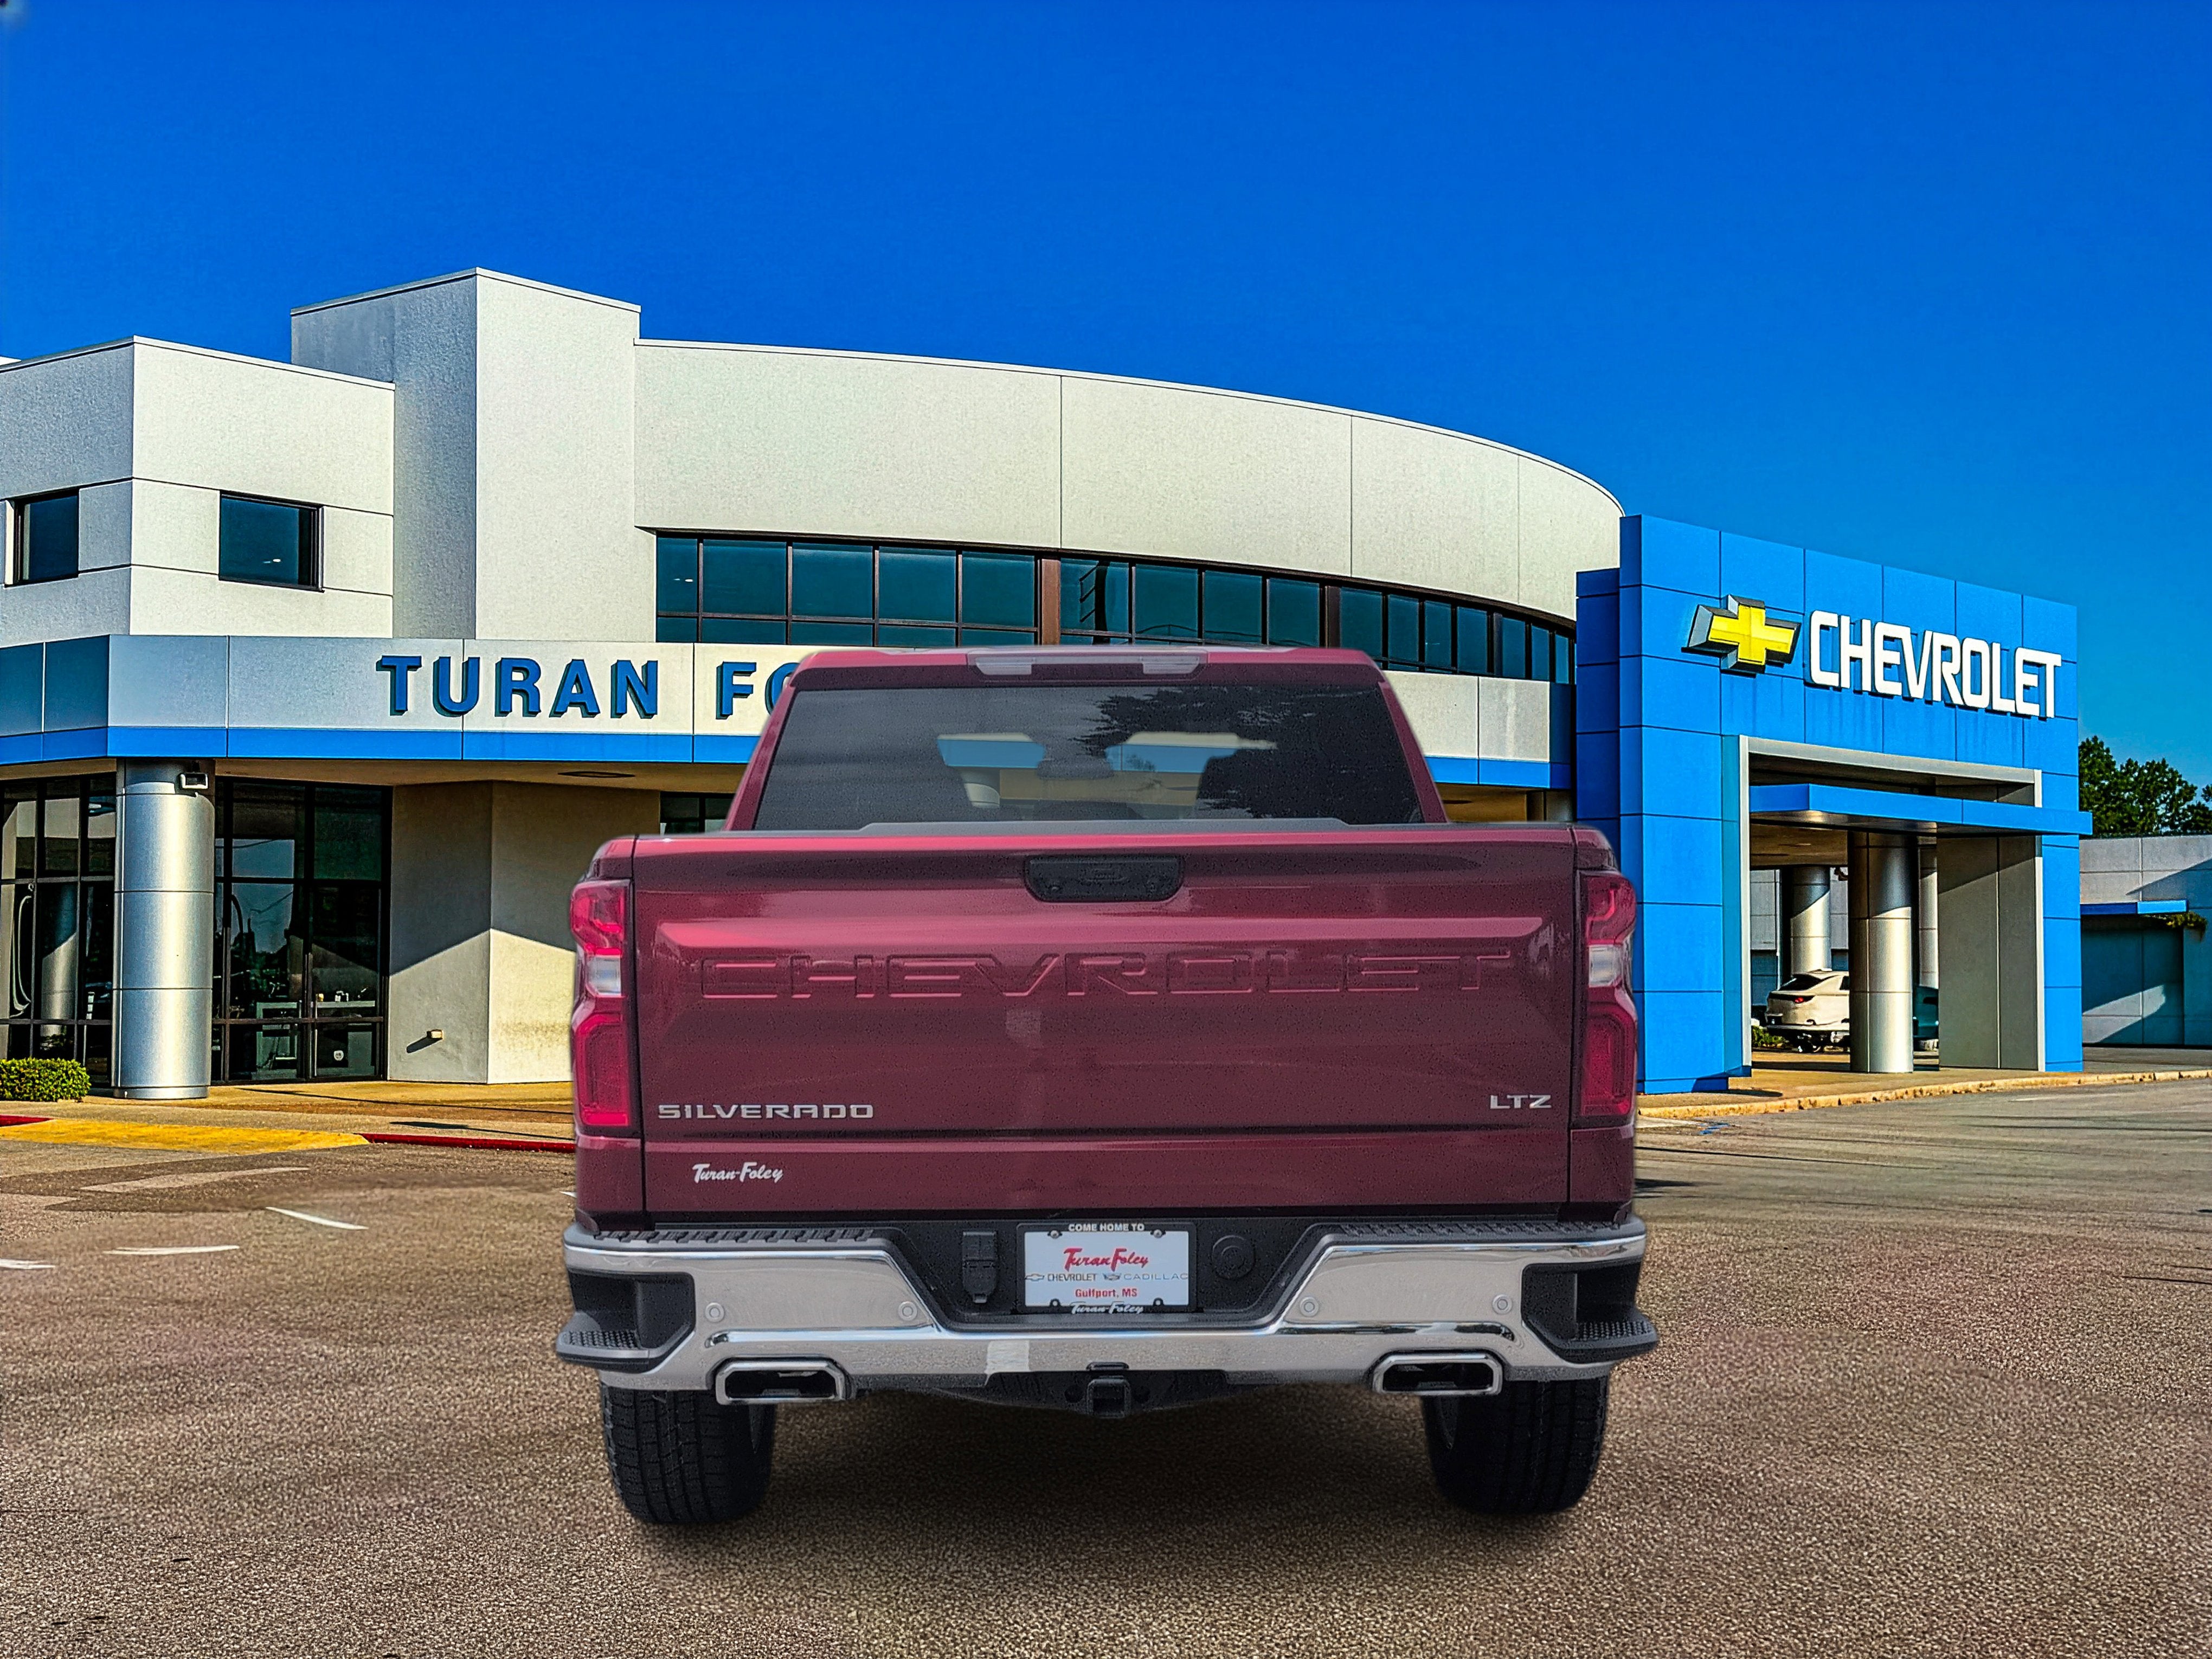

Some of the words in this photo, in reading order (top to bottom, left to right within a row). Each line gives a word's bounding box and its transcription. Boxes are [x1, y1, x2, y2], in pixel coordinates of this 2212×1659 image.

[1810, 609, 2062, 718] CHEVROLET
[376, 655, 658, 719] TURAN
[702, 950, 1510, 999] CHEVROLET
[1490, 1095, 1552, 1109] LTZ
[658, 1104, 874, 1120] SILVERADO
[1068, 1223, 1097, 1232] COME
[1131, 1223, 1145, 1231] TO
[1075, 1289, 1119, 1298] Gulfport,
[1121, 1288, 1137, 1297] MS
